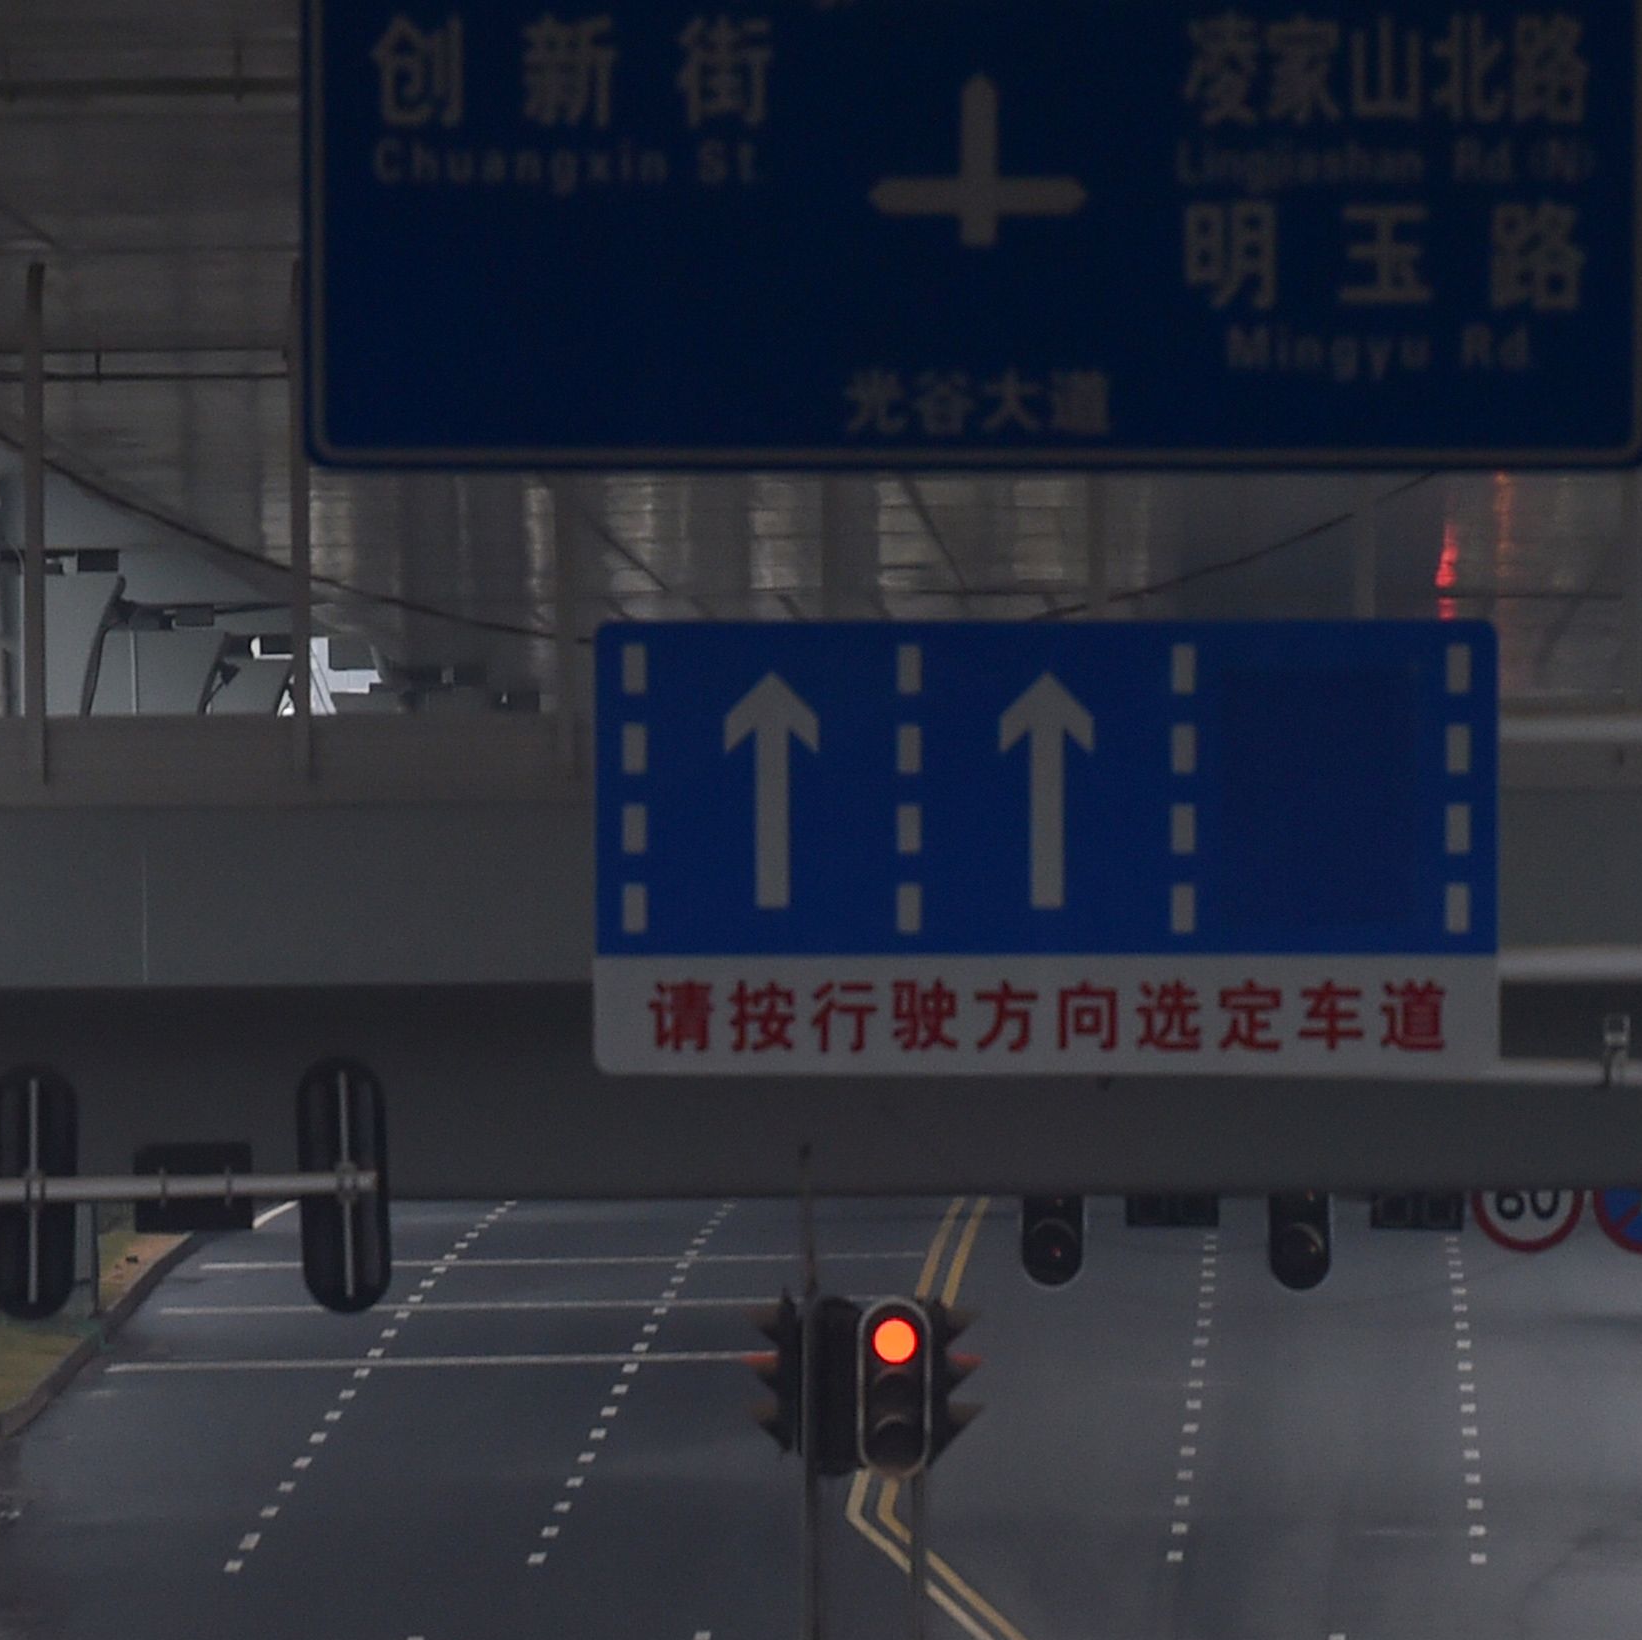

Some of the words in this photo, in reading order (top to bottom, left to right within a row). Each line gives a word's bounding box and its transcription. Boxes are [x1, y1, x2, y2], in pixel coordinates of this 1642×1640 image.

[370, 12, 775, 128] 创新街
[1183, 12, 1589, 126] 凌家山北路
[1183, 202, 1585, 311] 明玉路
[843, 366, 1112, 436] 光谷大道
[649, 981, 1447, 1053] 请按行驶方向选定车道
